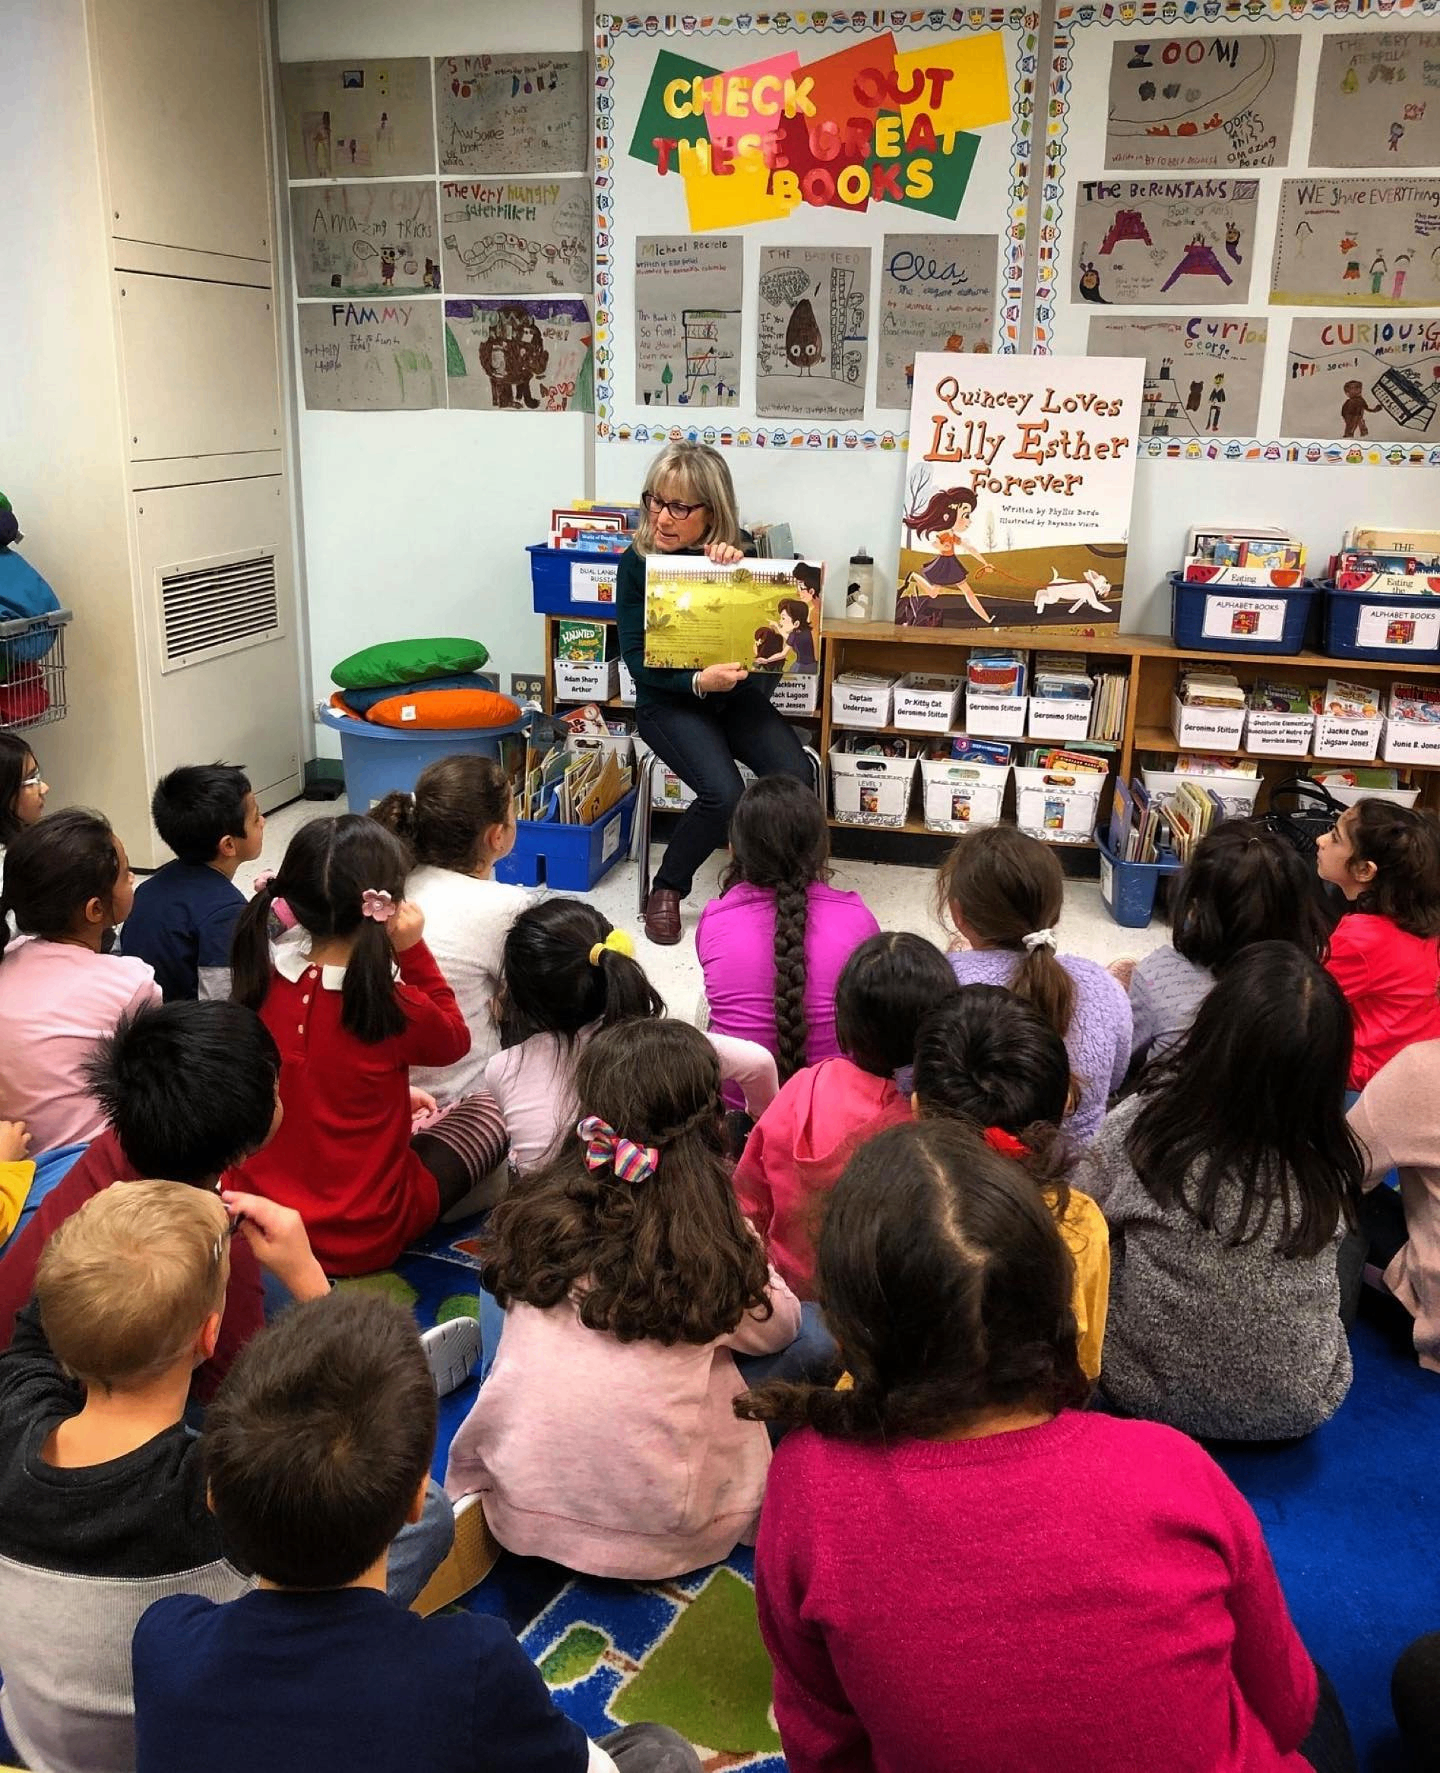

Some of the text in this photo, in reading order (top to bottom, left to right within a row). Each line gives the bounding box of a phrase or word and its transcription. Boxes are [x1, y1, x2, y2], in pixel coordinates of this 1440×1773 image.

[663, 67, 954, 119] CHECK OUT
[652, 128, 789, 177] THESE
[772, 158, 934, 208] BOOKS
[443, 183, 468, 199] The
[471, 184, 504, 204] Very
[1298, 184, 1325, 205] WE
[768, 250, 792, 259] THE
[935, 376, 1123, 417] Quincey Loves
[923, 415, 1129, 466] Lilly Esther
[969, 467, 1083, 496] Forever
[1002, 504, 1034, 514] Written
[1036, 507, 1046, 516] by
[1048, 507, 1074, 517] Phyllis
[999, 517, 1034, 525] Illustrated
[1036, 519, 1045, 527] by
[1392, 542, 1414, 552] THE
[580, 567, 596, 575] DUAL
[1231, 574, 1257, 584] Eating
[1387, 578, 1414, 587] Eating
[1216, 601, 1279, 611] ALPHABET BOOKS
[1370, 611, 1436, 620] ALPHABET BOOKS
[561, 628, 595, 644] HAUNTED
[582, 676, 599, 684] Sharp
[778, 680, 806, 690] ackberry
[786, 692, 809, 700] Lagoon
[849, 694, 873, 703] Captain
[843, 703, 878, 713] Underpants
[905, 698, 912, 706] Dr
[913, 699, 931, 709] Kitty
[969, 703, 1022, 712] Geronimo Stilton
[897, 709, 949, 719] Geronimo Stilton
[1034, 712, 1087, 722] Geronimo Stilton
[1184, 723, 1239, 734] Geronimo Stilton
[1350, 728, 1369, 736] Chan
[960, 741, 967, 749] 3
[1324, 739, 1349, 747] Jigsaw
[1421, 742, 1440, 750] Jones
